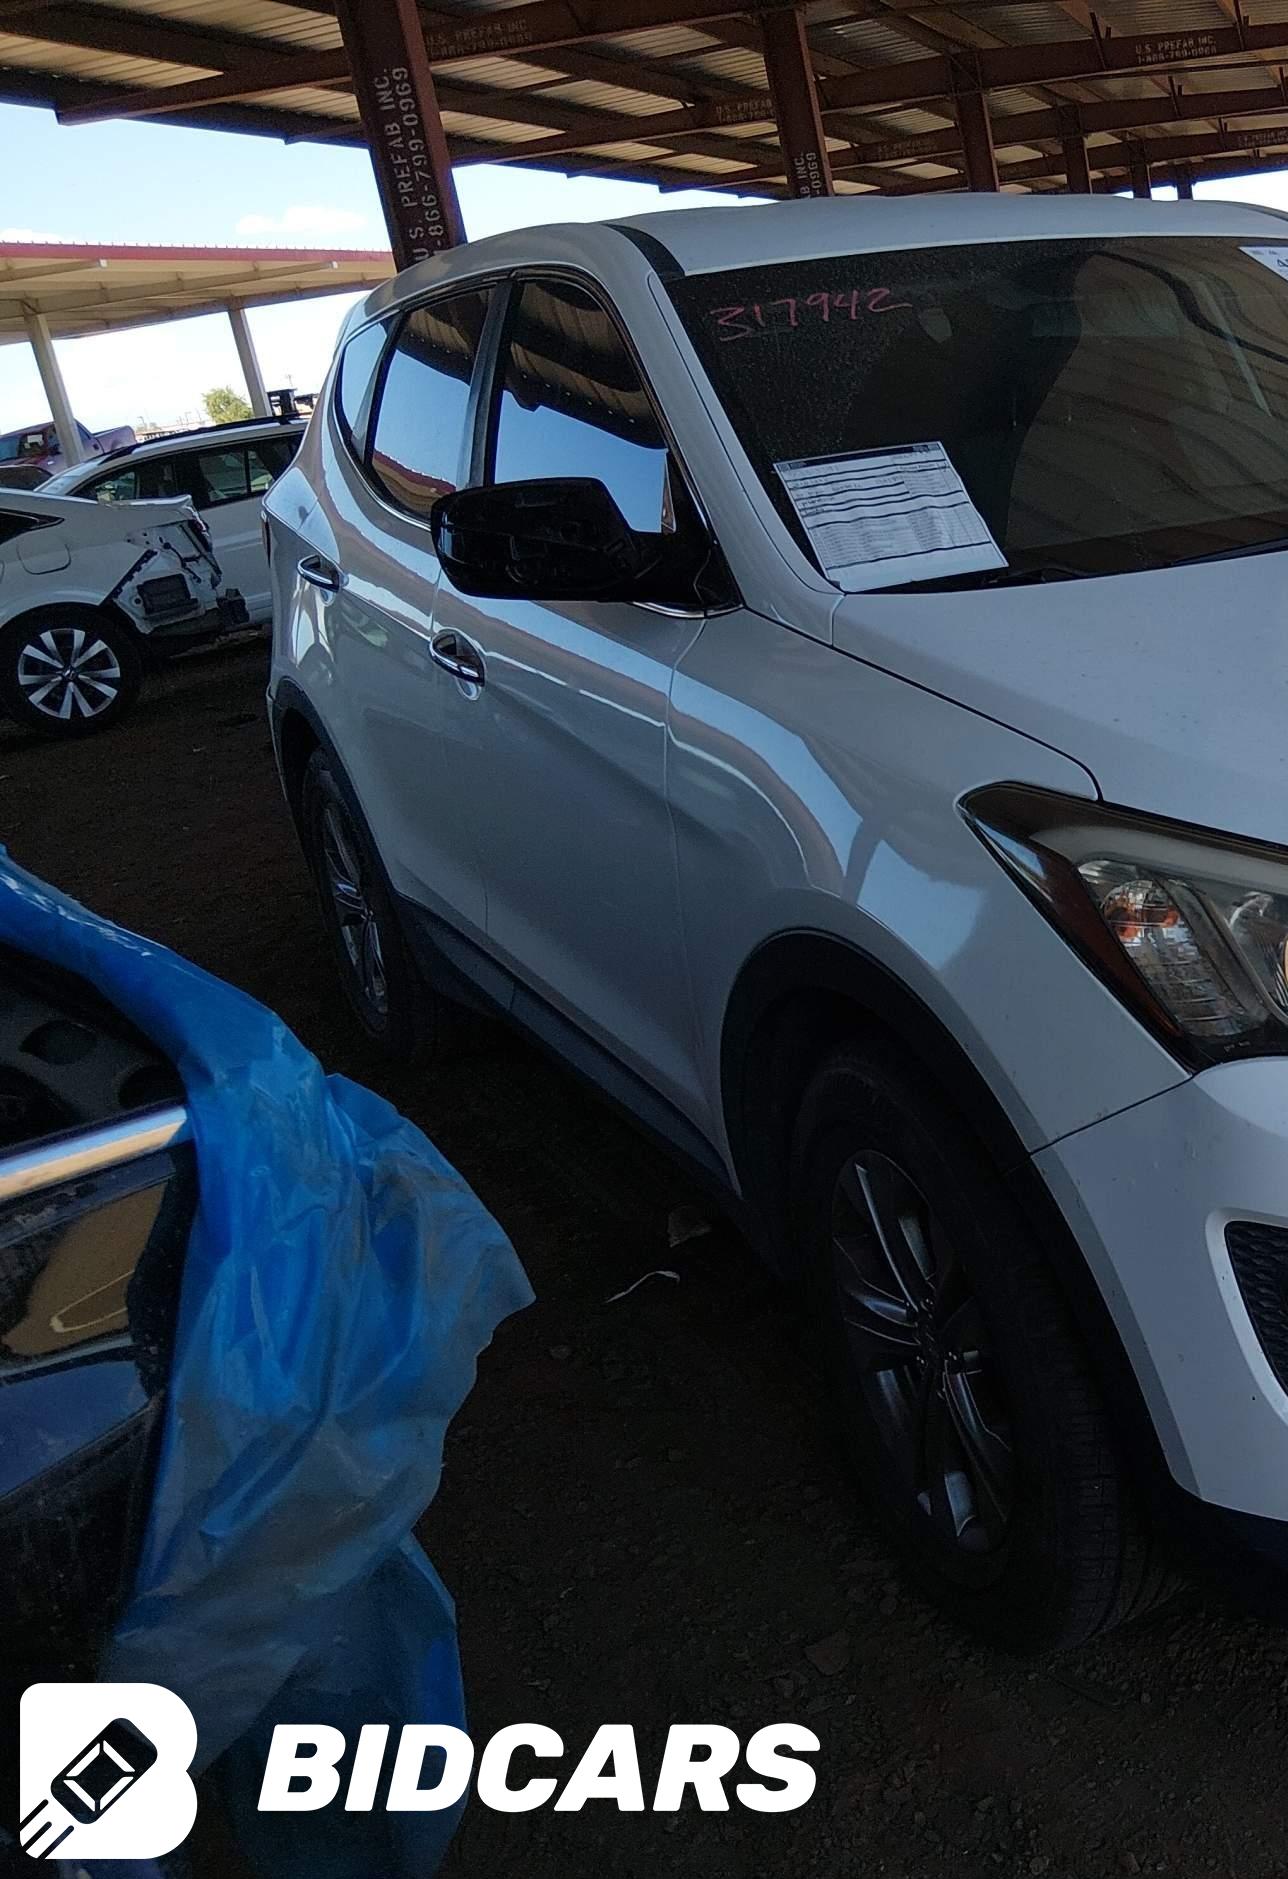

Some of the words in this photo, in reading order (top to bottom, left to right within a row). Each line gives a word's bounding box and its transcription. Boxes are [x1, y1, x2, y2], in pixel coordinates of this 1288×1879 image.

[374, 68, 395, 112] INC.
[384, 122, 419, 209] PREFAB
[709, 287, 913, 342] 317942
